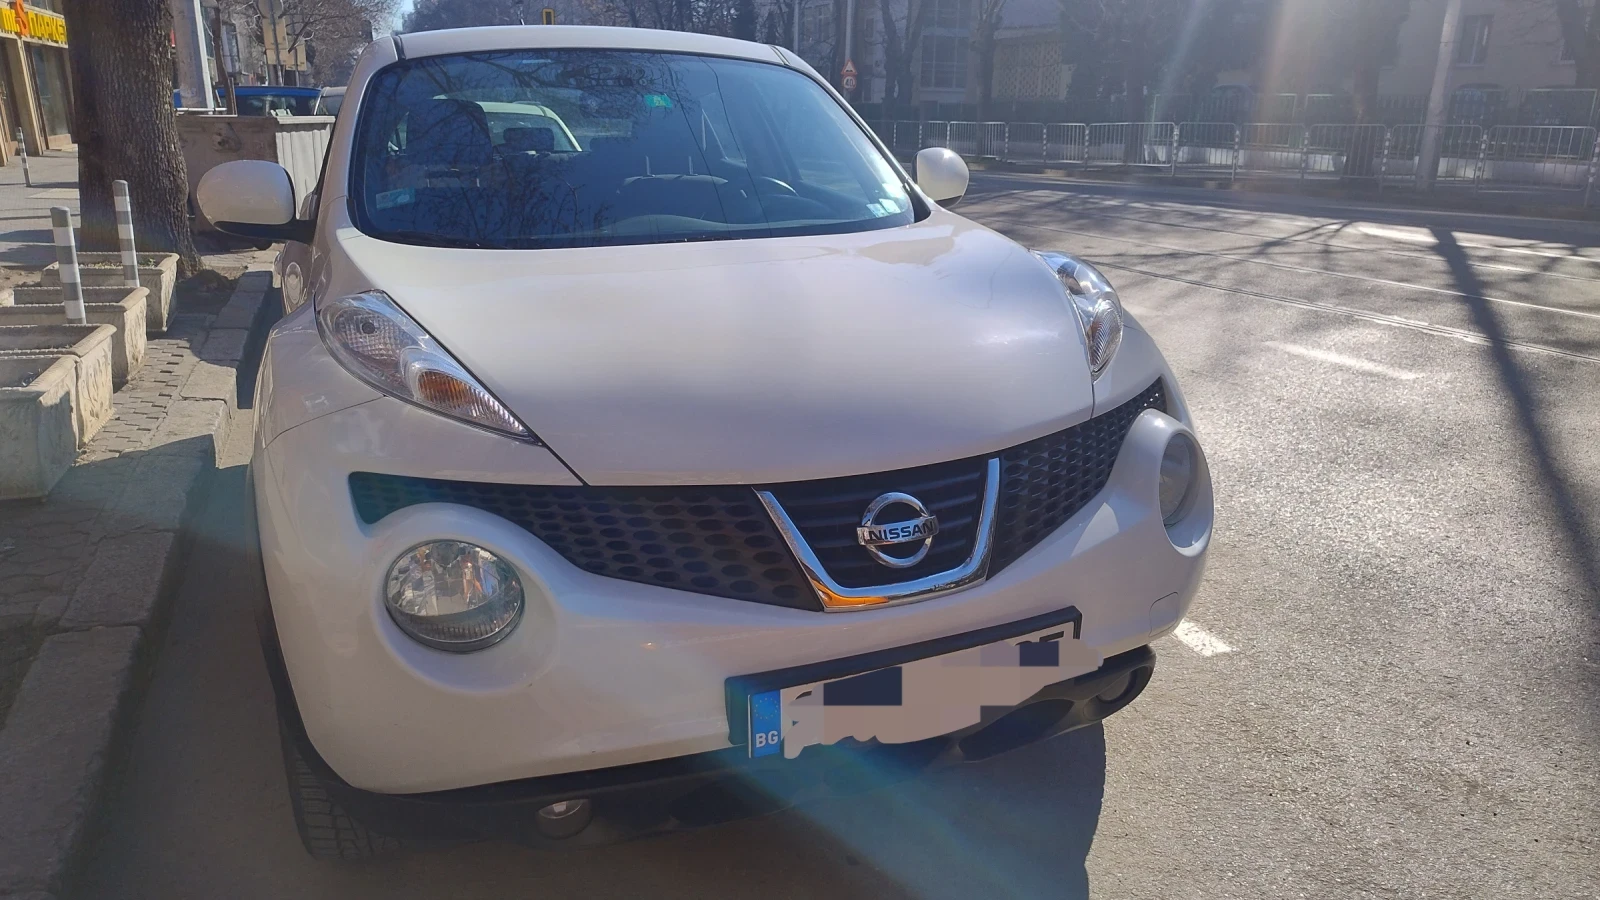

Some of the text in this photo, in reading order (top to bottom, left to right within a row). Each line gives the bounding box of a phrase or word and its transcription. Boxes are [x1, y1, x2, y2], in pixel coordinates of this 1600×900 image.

[845, 78, 854, 87] 40
[868, 520, 934, 541] NISSAN
[755, 730, 779, 748] BG
